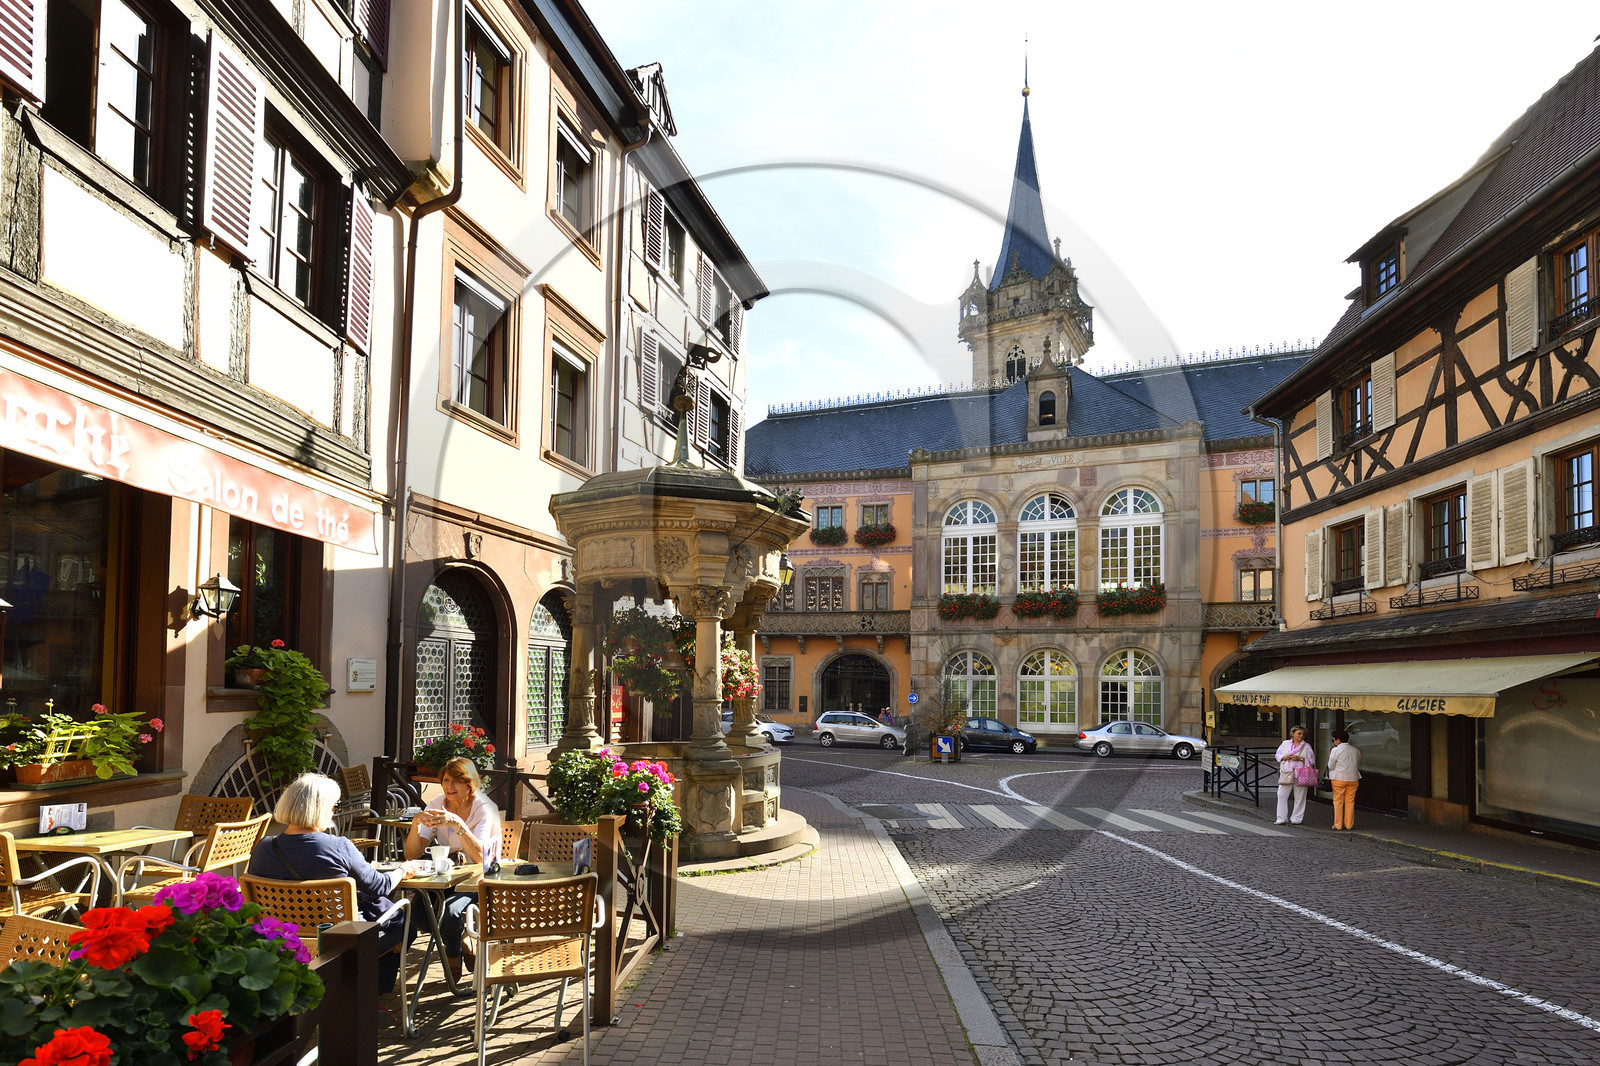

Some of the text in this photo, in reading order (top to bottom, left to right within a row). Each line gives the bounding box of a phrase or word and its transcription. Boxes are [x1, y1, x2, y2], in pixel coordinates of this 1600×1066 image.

[168, 455, 259, 516] Salon
[271, 493, 305, 529] de
[316, 506, 350, 542] thé
[1232, 694, 1249, 703] SALON
[1250, 694, 1258, 703] DE
[1303, 695, 1350, 708] SCHAEFFER
[1397, 698, 1446, 711] GLACIER
